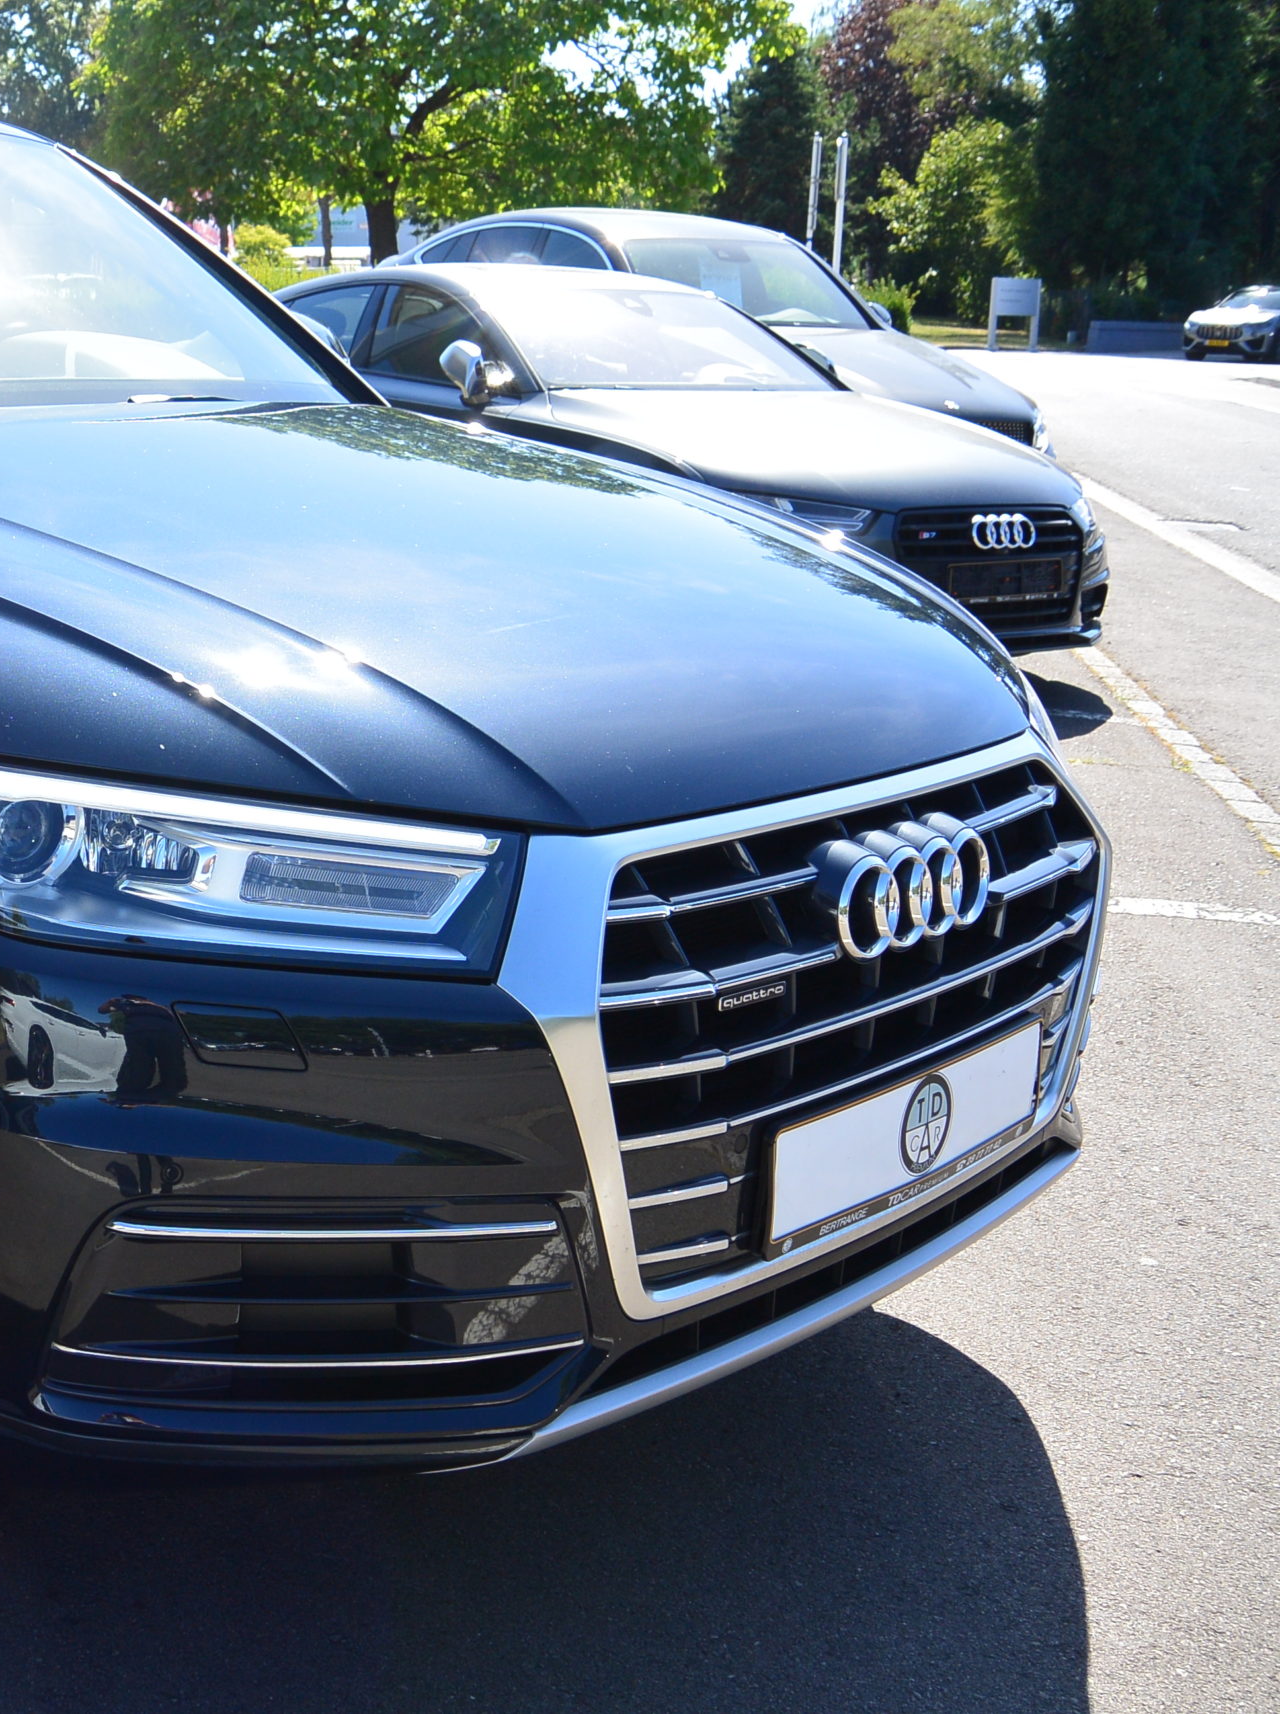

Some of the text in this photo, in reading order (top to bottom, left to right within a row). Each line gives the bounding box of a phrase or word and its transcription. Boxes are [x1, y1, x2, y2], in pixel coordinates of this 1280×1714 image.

[723, 985, 785, 1009] quattro
[910, 1123, 942, 1164] CAR
[819, 1207, 869, 1236] BERTRANGE
